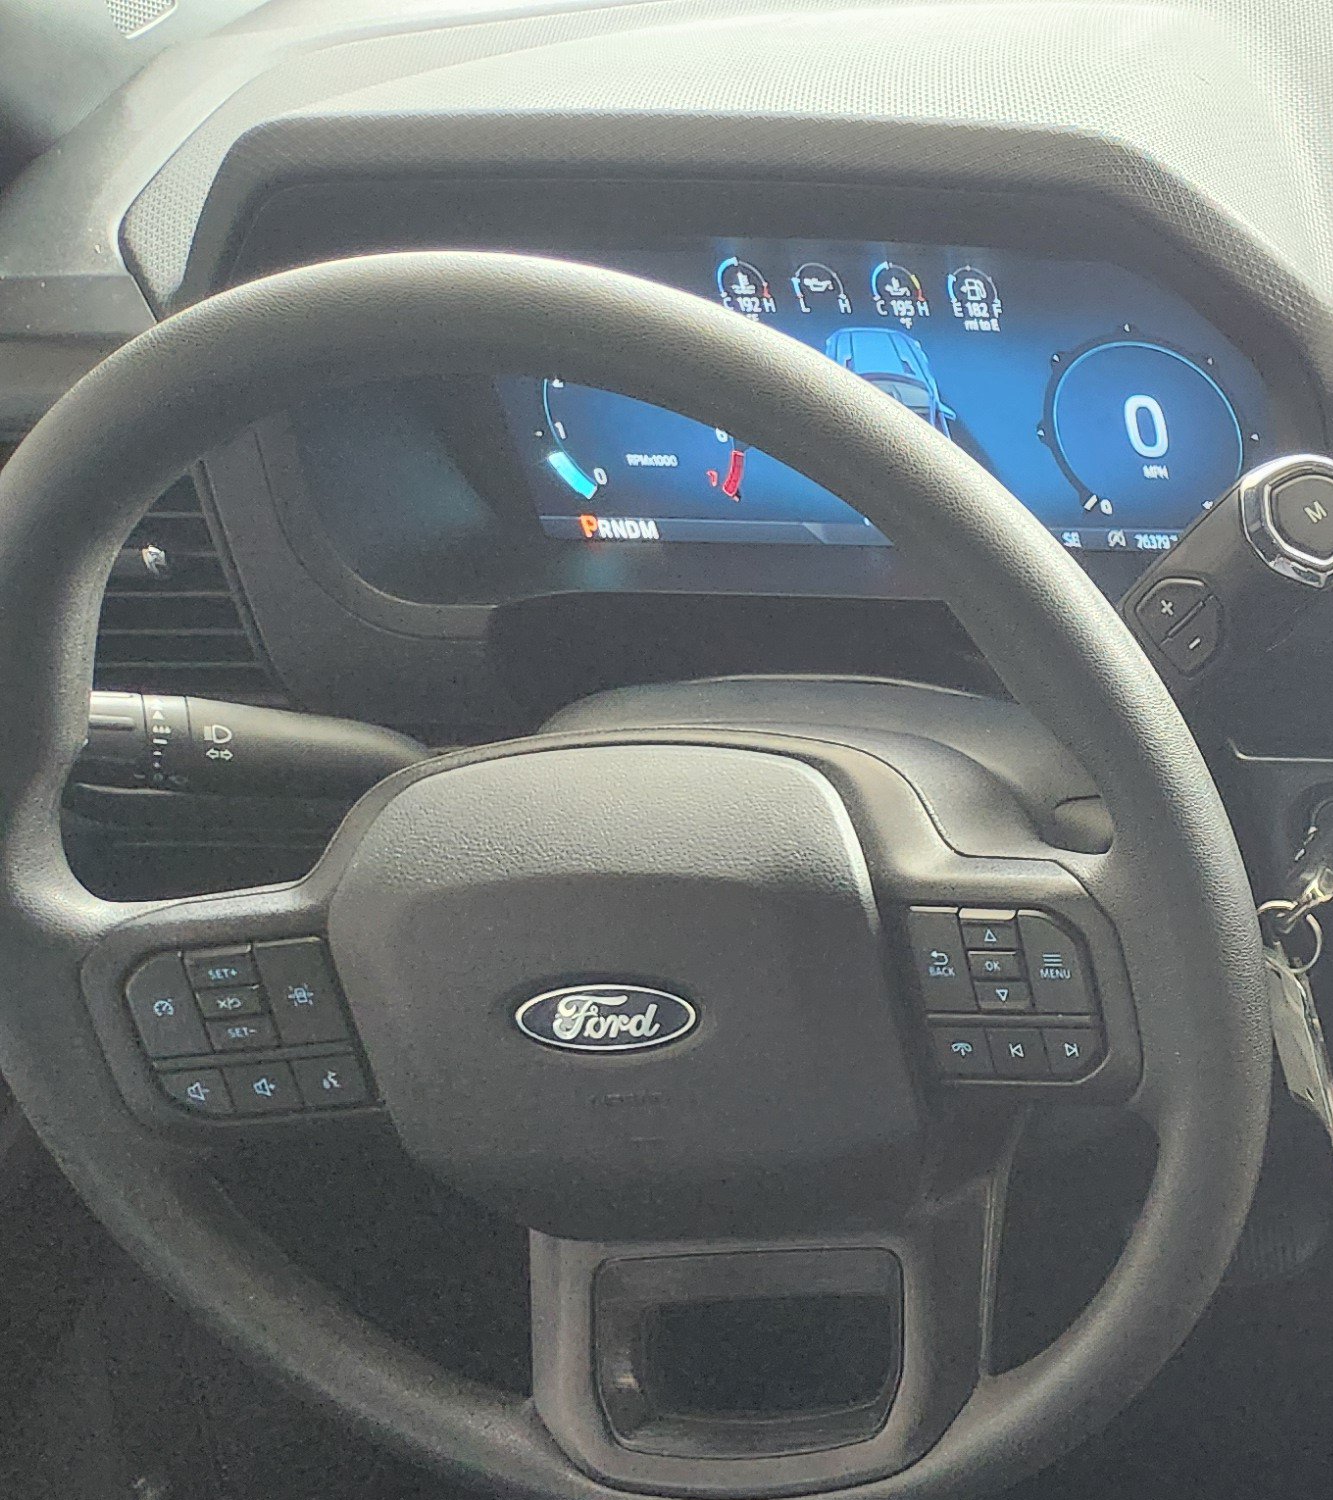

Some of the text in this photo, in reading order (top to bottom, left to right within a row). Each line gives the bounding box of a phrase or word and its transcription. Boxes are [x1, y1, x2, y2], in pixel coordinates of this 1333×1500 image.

[737, 296, 762, 313] 192
[763, 297, 777, 313] H
[800, 297, 852, 313] L H
[876, 299, 930, 317] C 195 H
[952, 301, 964, 318] E
[1124, 393, 1169, 459] 0
[593, 467, 608, 485] 0
[1303, 500, 1328, 524] M
[928, 966, 955, 977] BACK
[984, 960, 1001, 971] OK
[1039, 968, 1071, 980] MENU
[552, 994, 660, 1040] Ford
